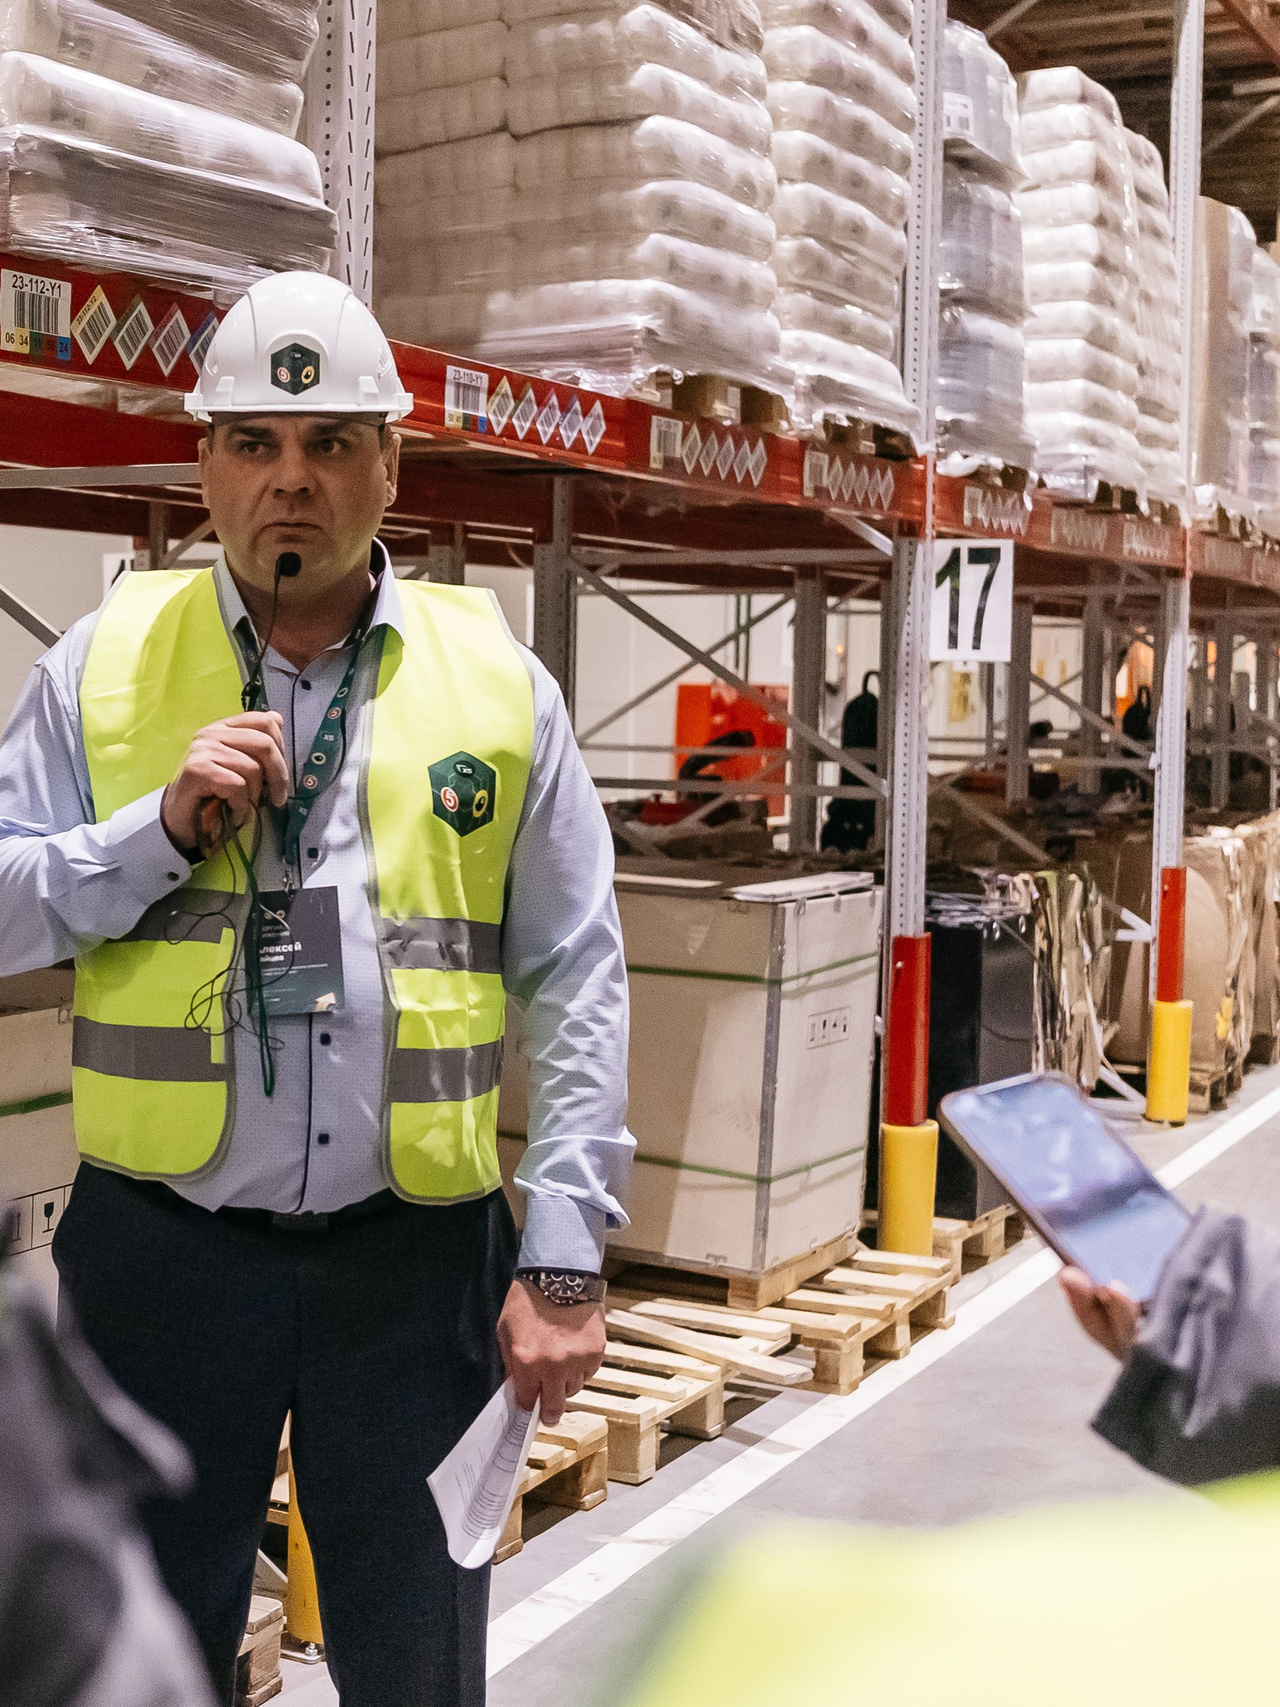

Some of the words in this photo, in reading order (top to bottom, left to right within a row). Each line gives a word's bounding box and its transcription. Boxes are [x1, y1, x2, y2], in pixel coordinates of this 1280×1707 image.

[11, 274, 62, 298] 23-112-Y1
[5, 331, 15, 344] 06
[19, 334, 29, 346] 34
[935, 546, 1001, 651] 17
